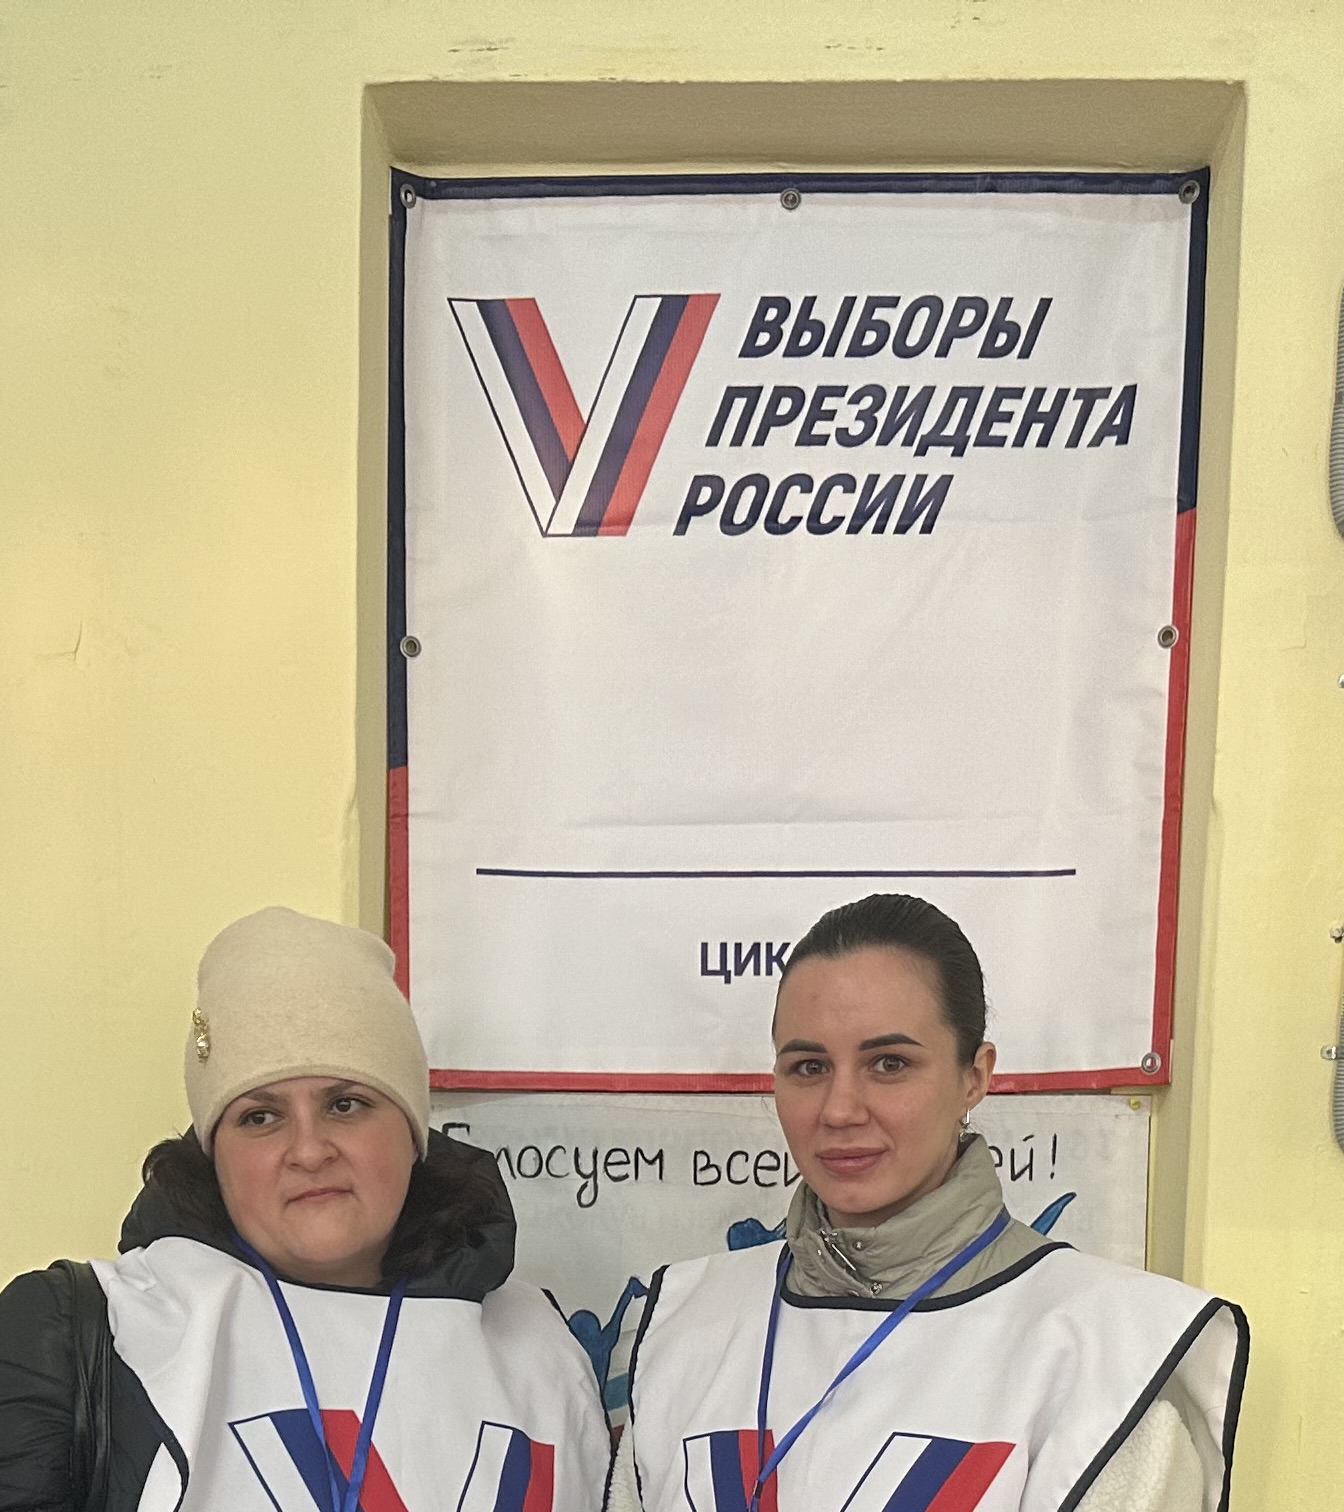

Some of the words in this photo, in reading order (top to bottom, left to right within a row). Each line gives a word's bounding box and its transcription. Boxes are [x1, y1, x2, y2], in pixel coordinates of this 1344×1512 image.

[738, 295, 1053, 360] ВЫБОРЫ
[705, 383, 1138, 458] ПРЕЗИДЕНТА
[672, 472, 954, 537] РОССИИ
[700, 941, 791, 985] ЦИК
